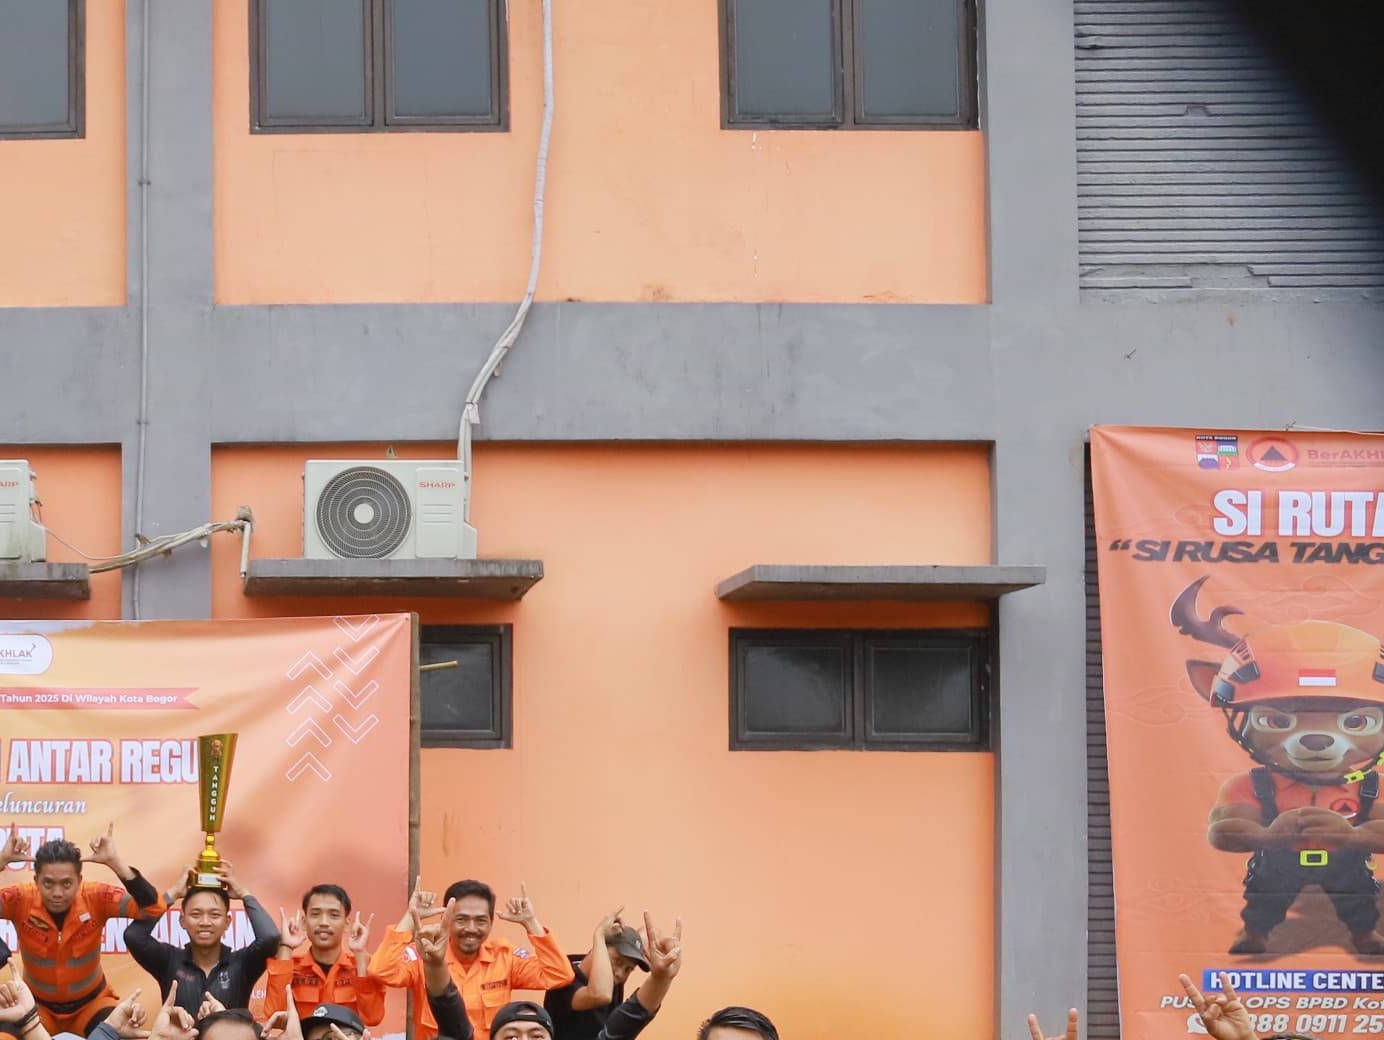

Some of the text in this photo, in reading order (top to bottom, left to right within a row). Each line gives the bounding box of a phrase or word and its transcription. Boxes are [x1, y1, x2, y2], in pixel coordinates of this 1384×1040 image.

[419, 481, 456, 489] SHARP
[1213, 489, 1262, 536] SI
[1172, 540, 1280, 564] RUSA
[0, 694, 32, 703] Tahun
[34, 694, 59, 703] 2025
[61, 694, 73, 703] Di
[75, 694, 117, 705] Wilayah
[119, 694, 144, 703] Kota
[146, 694, 177, 705] Bogor
[6, 738, 113, 784] ANTAR
[119, 738, 199, 784] REGU
[209, 766, 219, 821] TANGGUH
[1210, 972, 1307, 989] HOTLINE
[1246, 996, 1290, 1009] OPS
[1296, 996, 1348, 1009] BPBD
[1295, 1013, 1347, 1033] 0911
